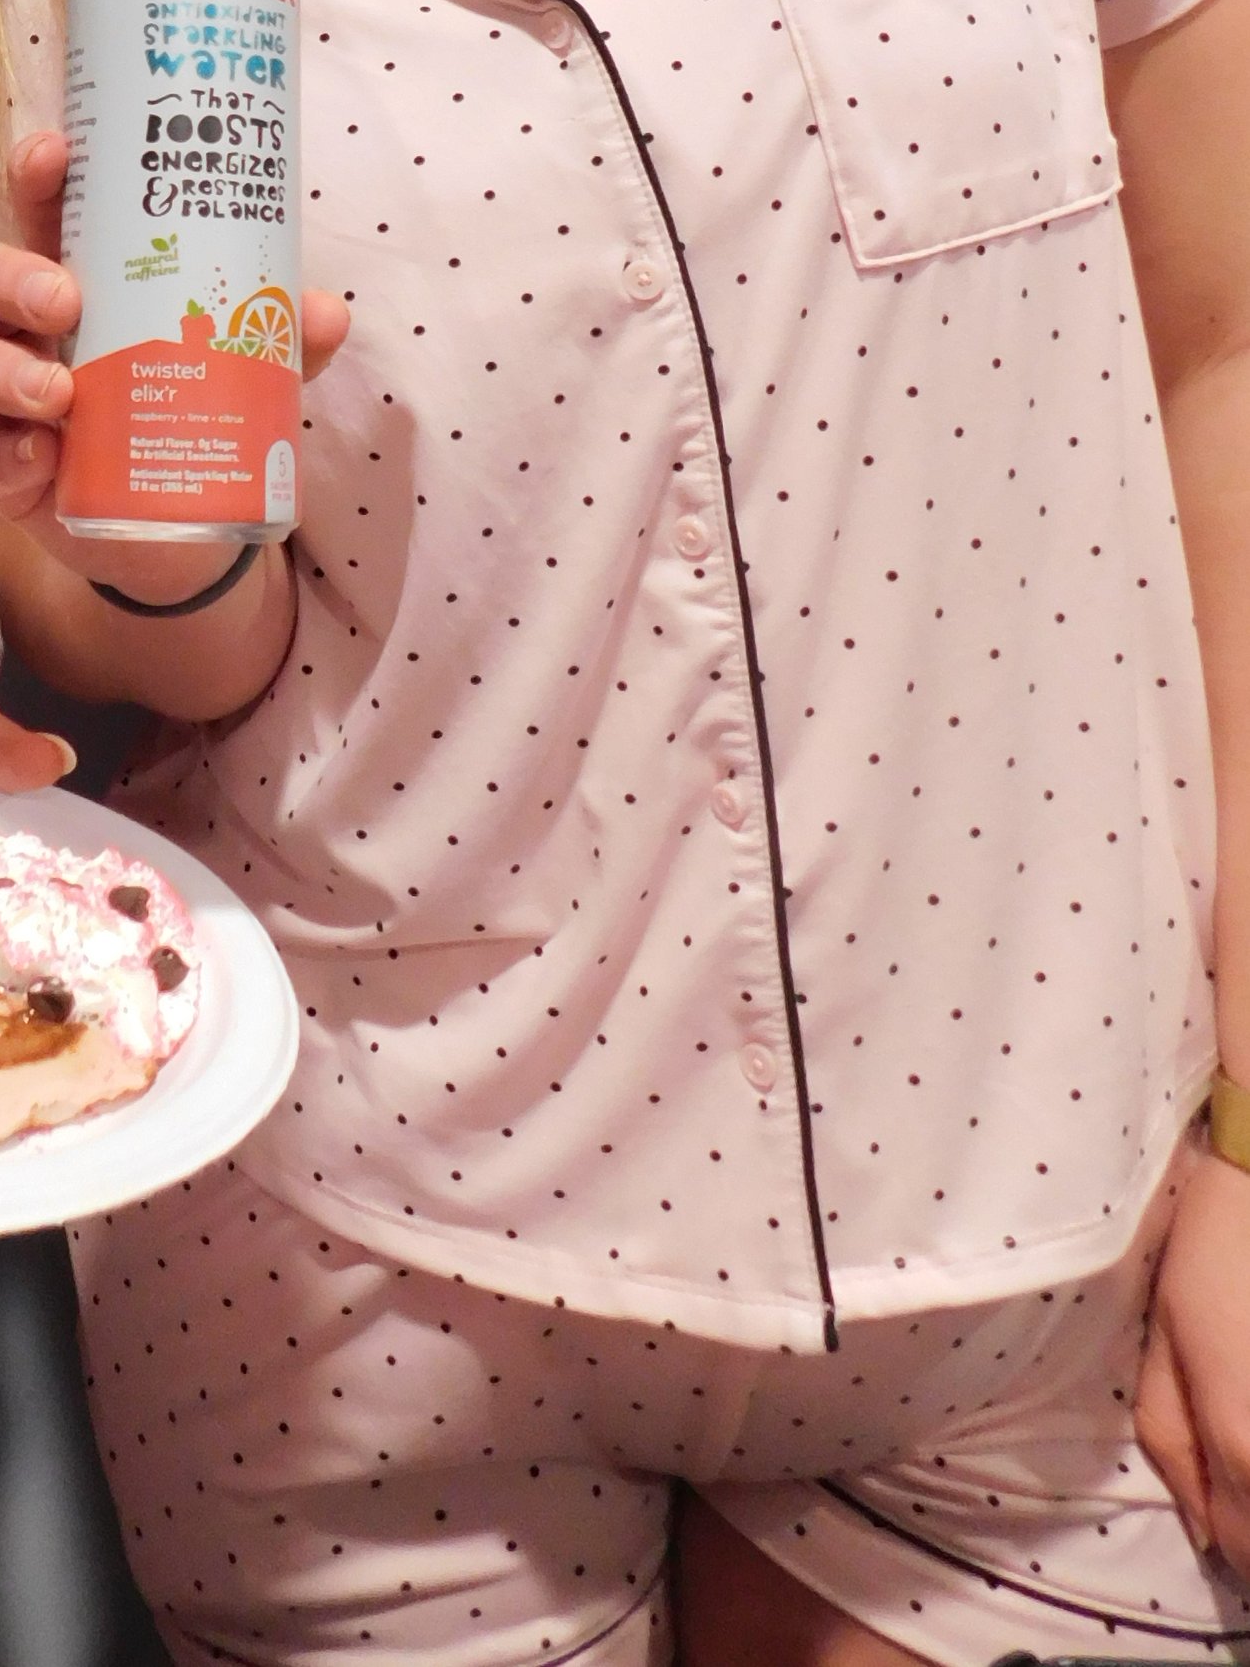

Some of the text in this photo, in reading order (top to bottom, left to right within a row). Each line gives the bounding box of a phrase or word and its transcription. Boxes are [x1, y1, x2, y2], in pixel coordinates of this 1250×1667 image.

[146, 114, 285, 151] BOOSTS
[142, 176, 179, 217] &
[124, 248, 179, 268] natural
[124, 265, 180, 282] caffeine
[131, 362, 206, 380] twisted
[131, 385, 177, 402] elix'r
[131, 413, 244, 424] raspberry lime citrus
[130, 436, 163, 448] Natural
[143, 449, 185, 460] Artificial
[184, 470, 228, 483] Sparkling
